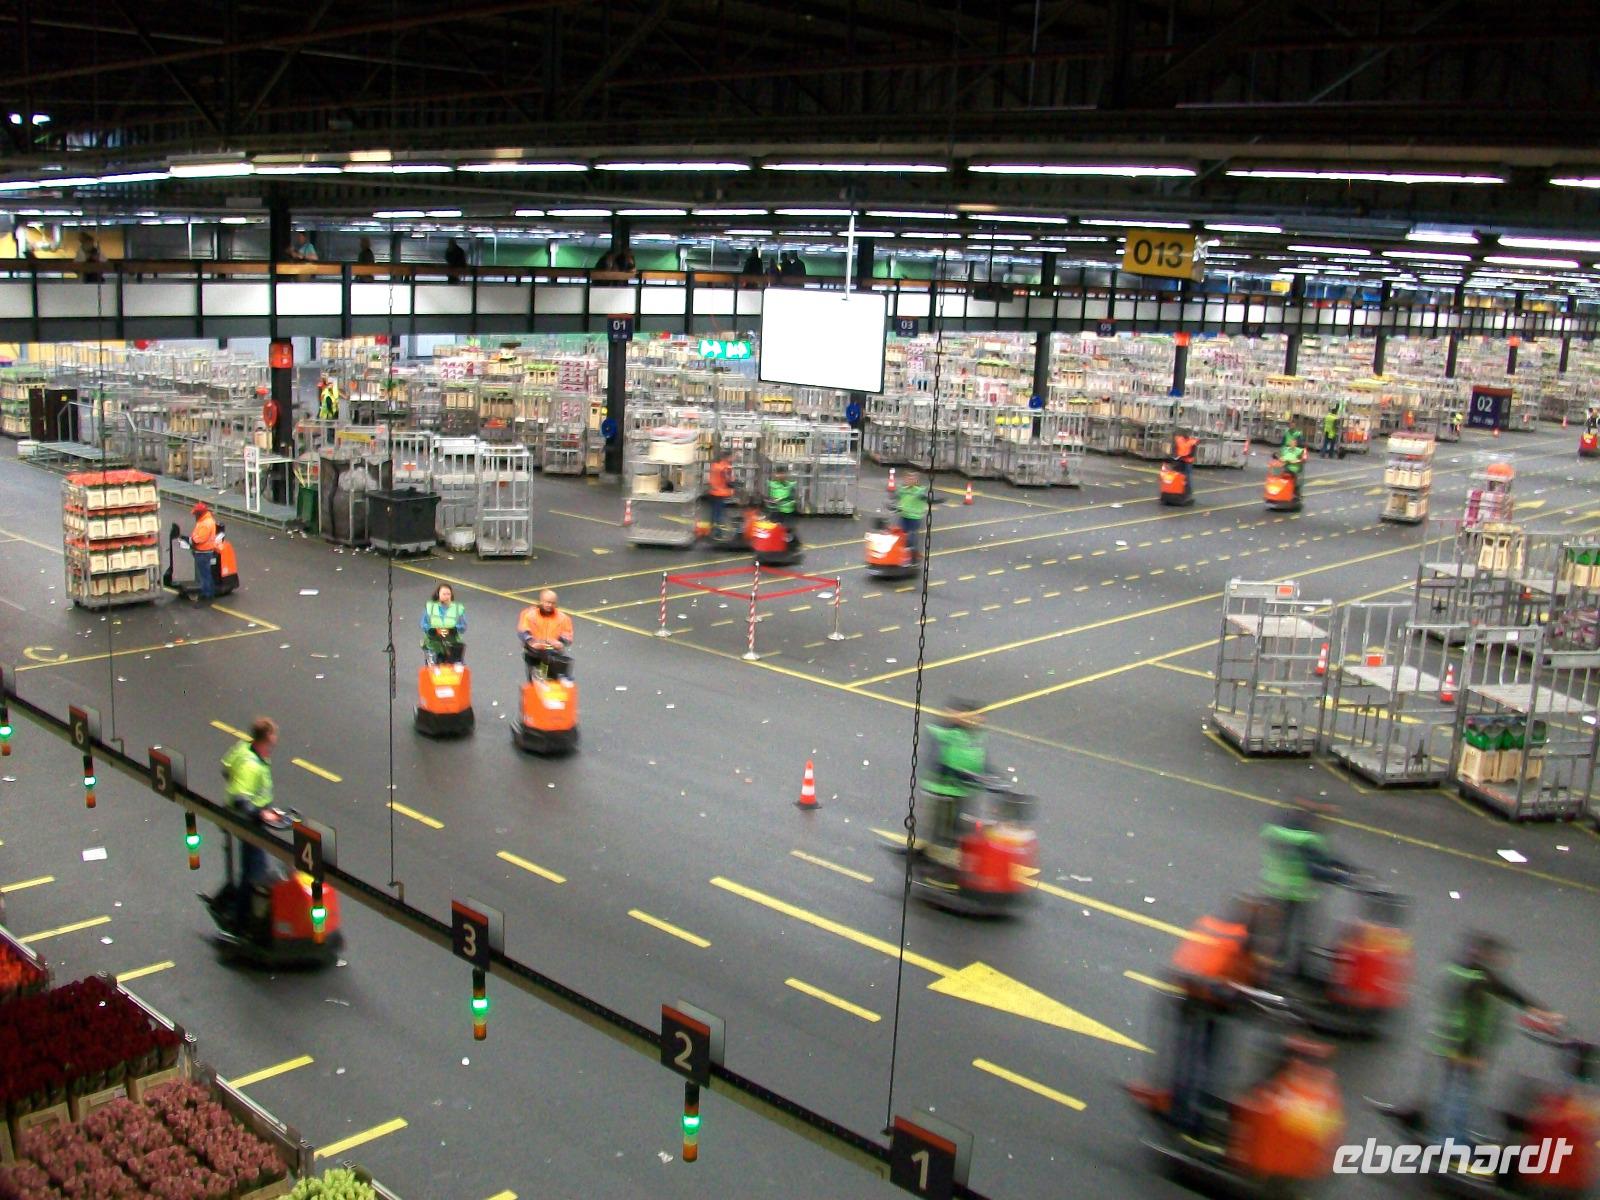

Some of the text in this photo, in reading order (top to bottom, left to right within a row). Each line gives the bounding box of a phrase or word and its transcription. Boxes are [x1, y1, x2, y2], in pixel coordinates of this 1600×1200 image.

[1133, 239, 1185, 269] 013
[613, 320, 626, 331] 01
[901, 319, 913, 330] 03
[1477, 395, 1493, 412] 02
[75, 721, 84, 745] 6
[156, 764, 167, 791] 5
[301, 841, 314, 871] 4
[462, 922, 477, 957] 3
[673, 1031, 693, 1071] 2
[911, 1149, 930, 1192] 1
